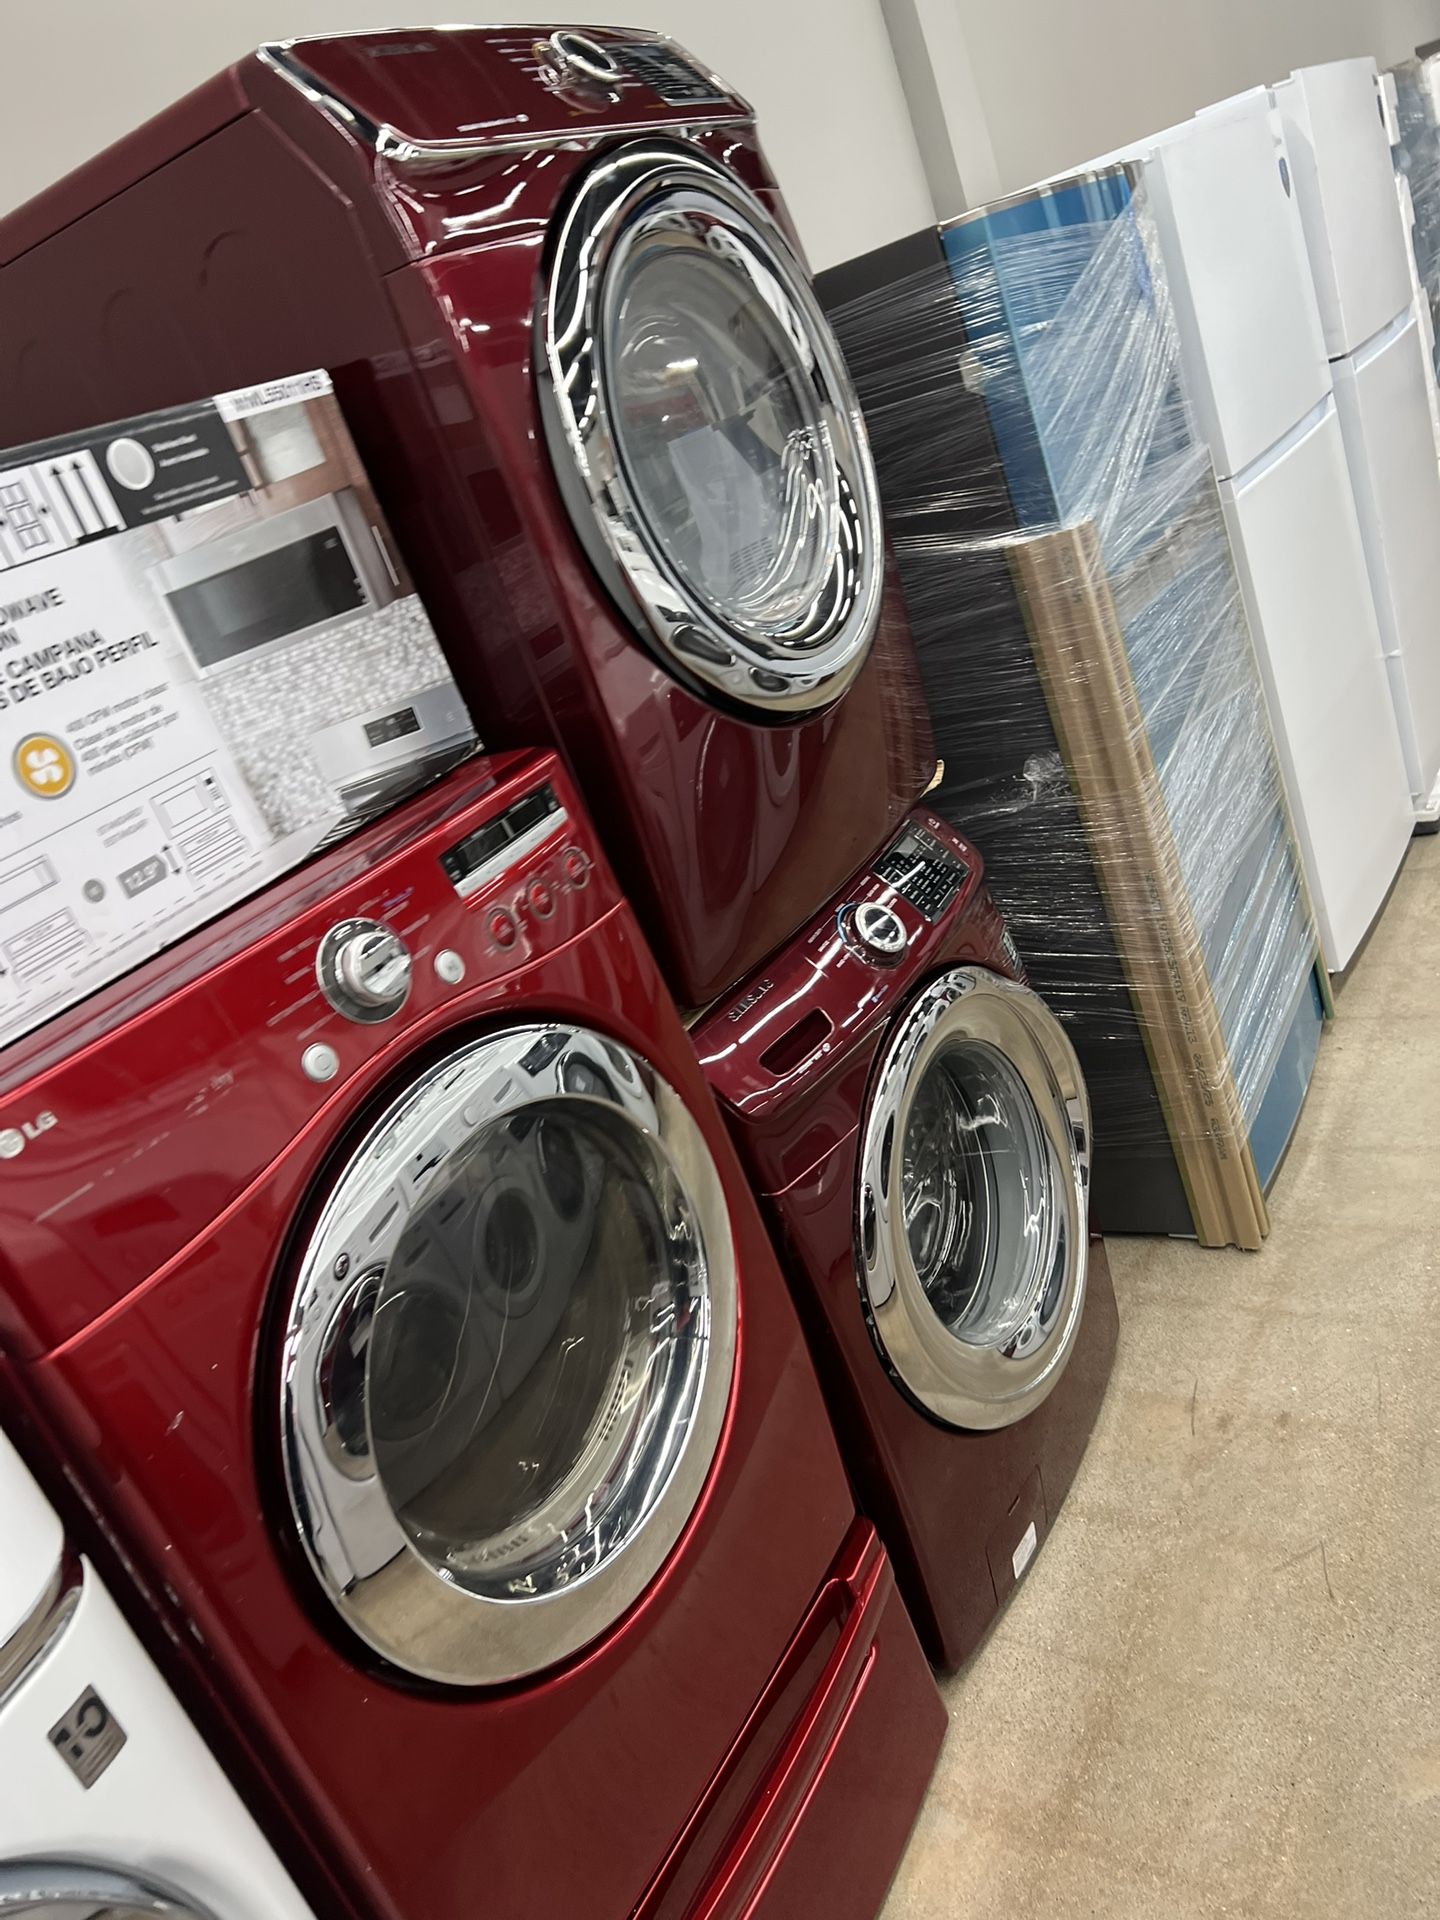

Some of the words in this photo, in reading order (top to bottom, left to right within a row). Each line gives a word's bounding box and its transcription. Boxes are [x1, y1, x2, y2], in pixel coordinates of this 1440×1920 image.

[5, 628, 105, 679] CAMPANA
[7, 678, 42, 704] DE
[39, 656, 94, 690] BAJO
[94, 631, 159, 669] PERFIL
[21, 1110, 58, 1140] LG
